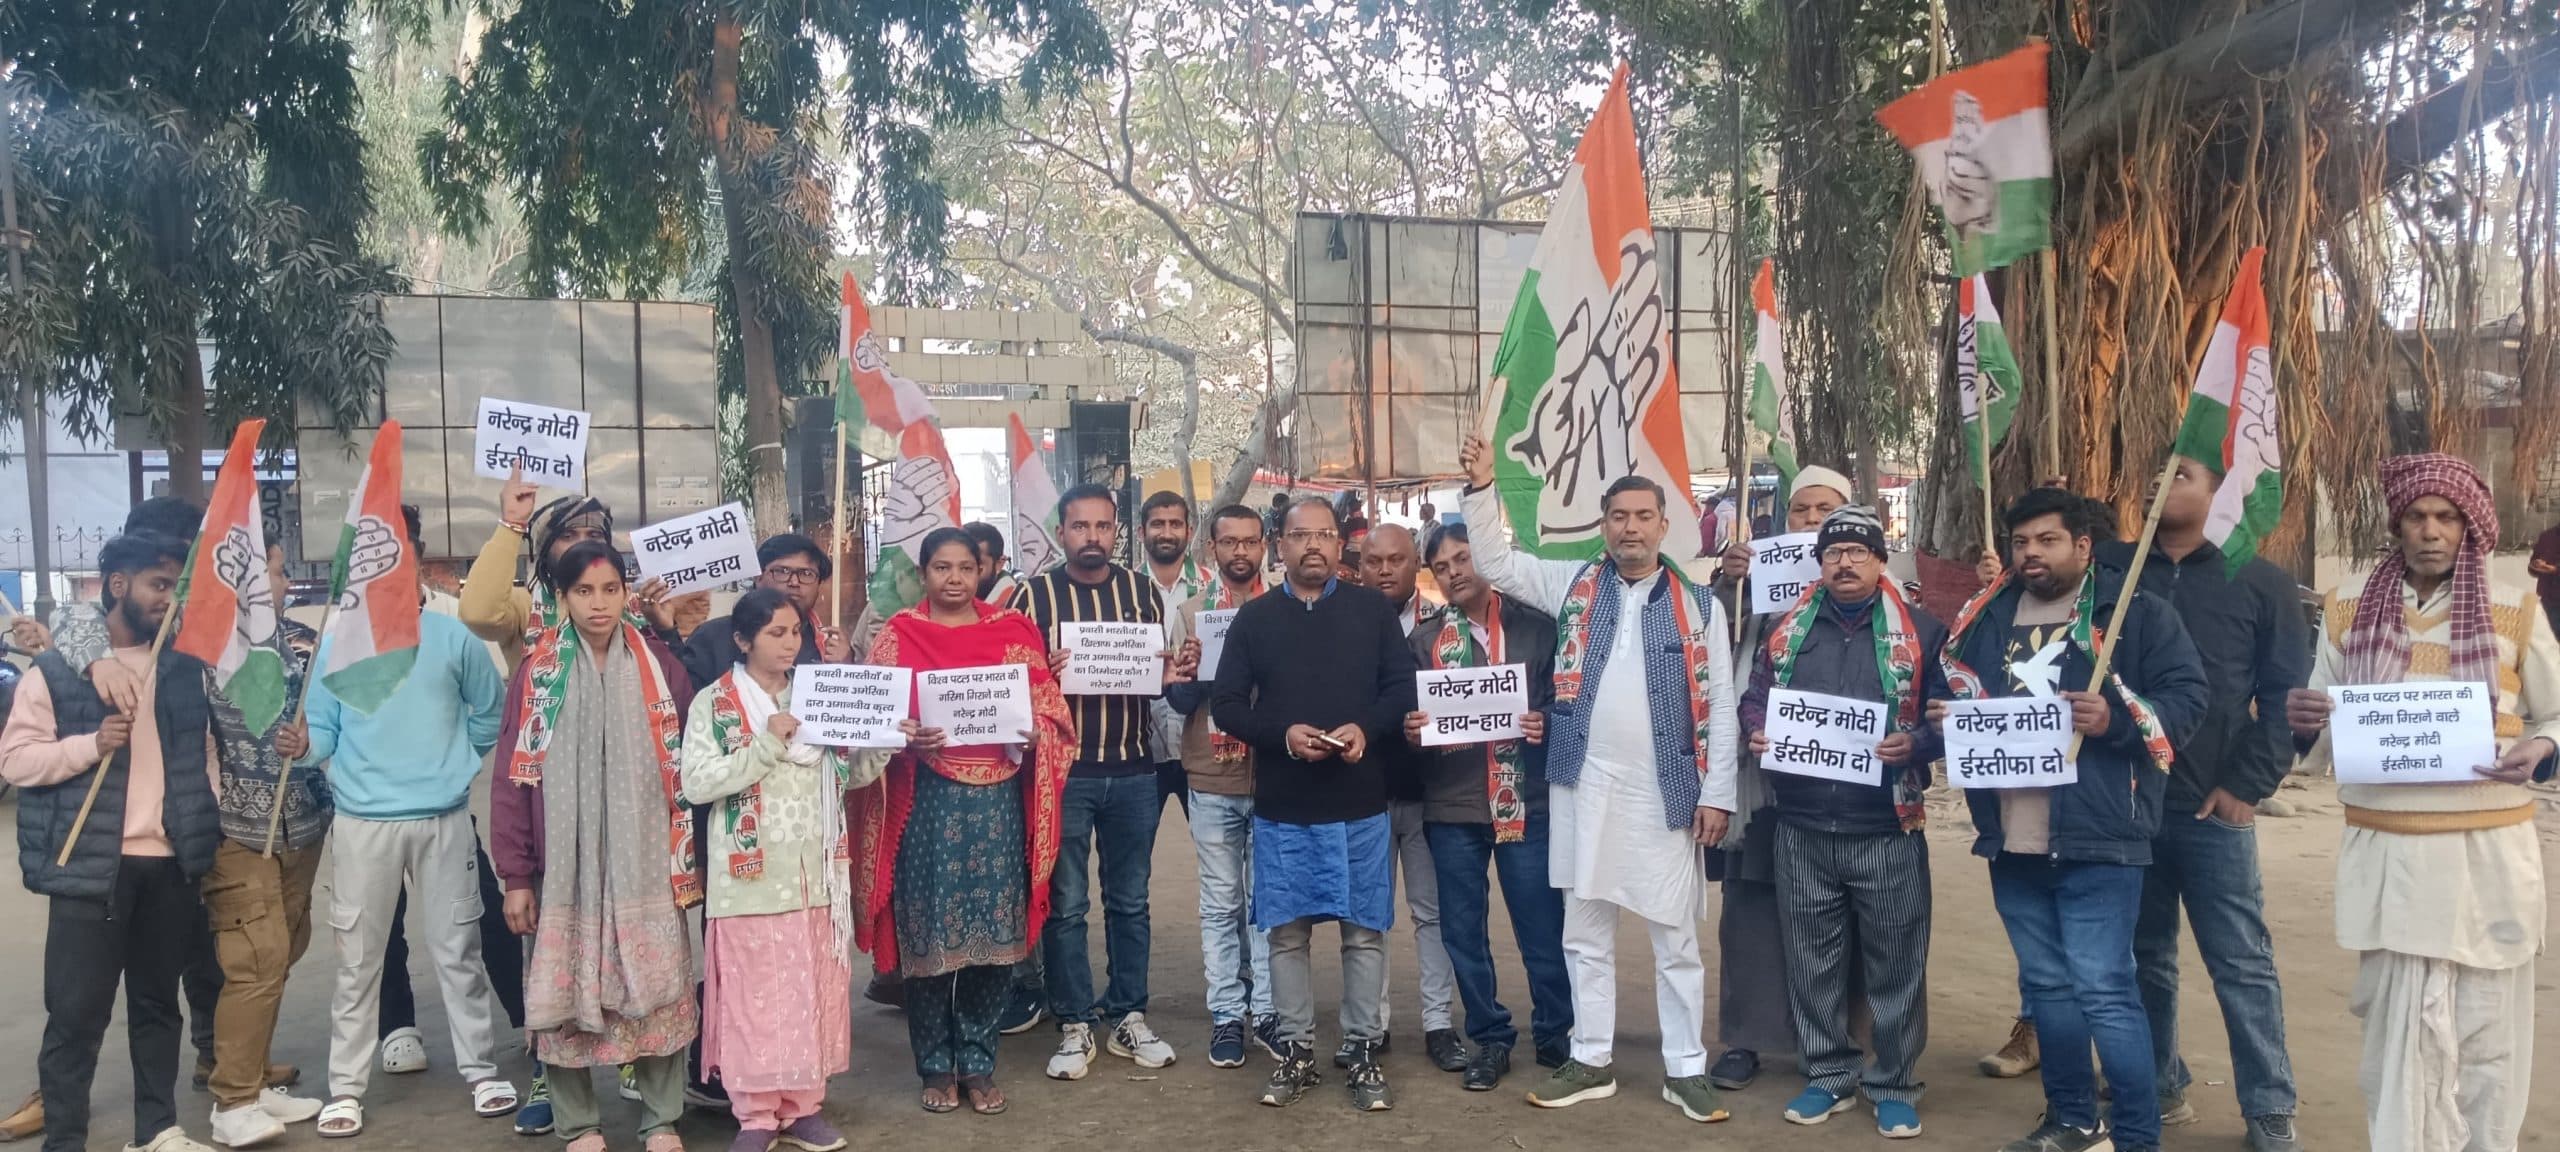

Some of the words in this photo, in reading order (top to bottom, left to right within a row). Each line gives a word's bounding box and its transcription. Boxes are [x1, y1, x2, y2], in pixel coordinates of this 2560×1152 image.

[488, 406, 534, 436] नरेन्द्र
[537, 413, 580, 440] मोदी
[485, 443, 549, 475] ईस्तीफा
[552, 454, 573, 478] दो
[643, 528, 693, 553] नरेन्द्र
[696, 511, 739, 540] मोदी
[1828, 524, 1868, 536] BFG
[1760, 542, 1805, 565] नरेन्द्र
[662, 554, 741, 589] हाय-हाय
[1079, 625, 1104, 635] प्रवासी
[1081, 637, 1111, 648] खिलाफ
[1113, 638, 1146, 649] अमेरिका
[1092, 652, 1130, 662] अमानवीय
[1132, 655, 1151, 665] कृत्य
[814, 668, 841, 679] प्रवासी
[928, 673, 948, 685] विश्व
[950, 674, 970, 684] पटल
[971, 673, 983, 683] पर
[985, 673, 1006, 681] भारत
[1008, 669, 1019, 681] की
[1074, 666, 1086, 675] का
[1145, 668, 1150, 676] ?
[814, 681, 849, 694] खिलाफ
[851, 685, 889, 697] अमेरिका
[1090, 680, 1111, 689] नरेन्द्र
[1113, 680, 1132, 689] मोदी
[1427, 674, 1474, 699] नरेन्द्र
[1478, 670, 1518, 694] मोदी
[939, 690, 964, 702] गरिमा
[966, 688, 991, 701] गिराने
[993, 687, 1011, 699] वाले
[2342, 690, 2369, 704] विश्व
[2373, 690, 2400, 702] पटल
[2404, 690, 2419, 702] पर
[2422, 689, 2453, 700] भारत
[2456, 686, 2473, 700] की
[805, 699, 824, 708] द्वारा
[826, 700, 870, 710] अमानवीय
[872, 703, 895, 714] कृत्य
[953, 707, 976, 719] नरेन्द्र
[978, 705, 997, 717] मोदी
[804, 713, 818, 723] का
[820, 712, 861, 725] जिम्मेदार
[886, 718, 892, 726] ?
[1436, 713, 1512, 734] हाय-हाय
[1778, 697, 1831, 728] नरेन्द्र
[1834, 706, 1877, 734] मोदी
[1955, 707, 2008, 736] नरेन्द्र
[2013, 703, 2062, 731] मोदी
[2358, 710, 2393, 726] गरिमा
[2397, 709, 2432, 724] गिराने
[2435, 707, 2460, 723] वाले
[822, 728, 847, 740] नरेन्द्र
[849, 730, 870, 740] मोदी
[954, 723, 985, 736] ईस्तीफा
[987, 723, 997, 734] दो
[2379, 733, 2411, 748] नरेन्द्र
[2414, 731, 2441, 746] मोदी
[1774, 735, 1848, 769] ईस्तीफा
[1851, 749, 1872, 773] दो
[1958, 748, 2035, 779] ईस्तीफा
[2040, 747, 2064, 774] दो
[2381, 755, 2426, 772] ईस्तीफा
[2429, 754, 2442, 769] दो
